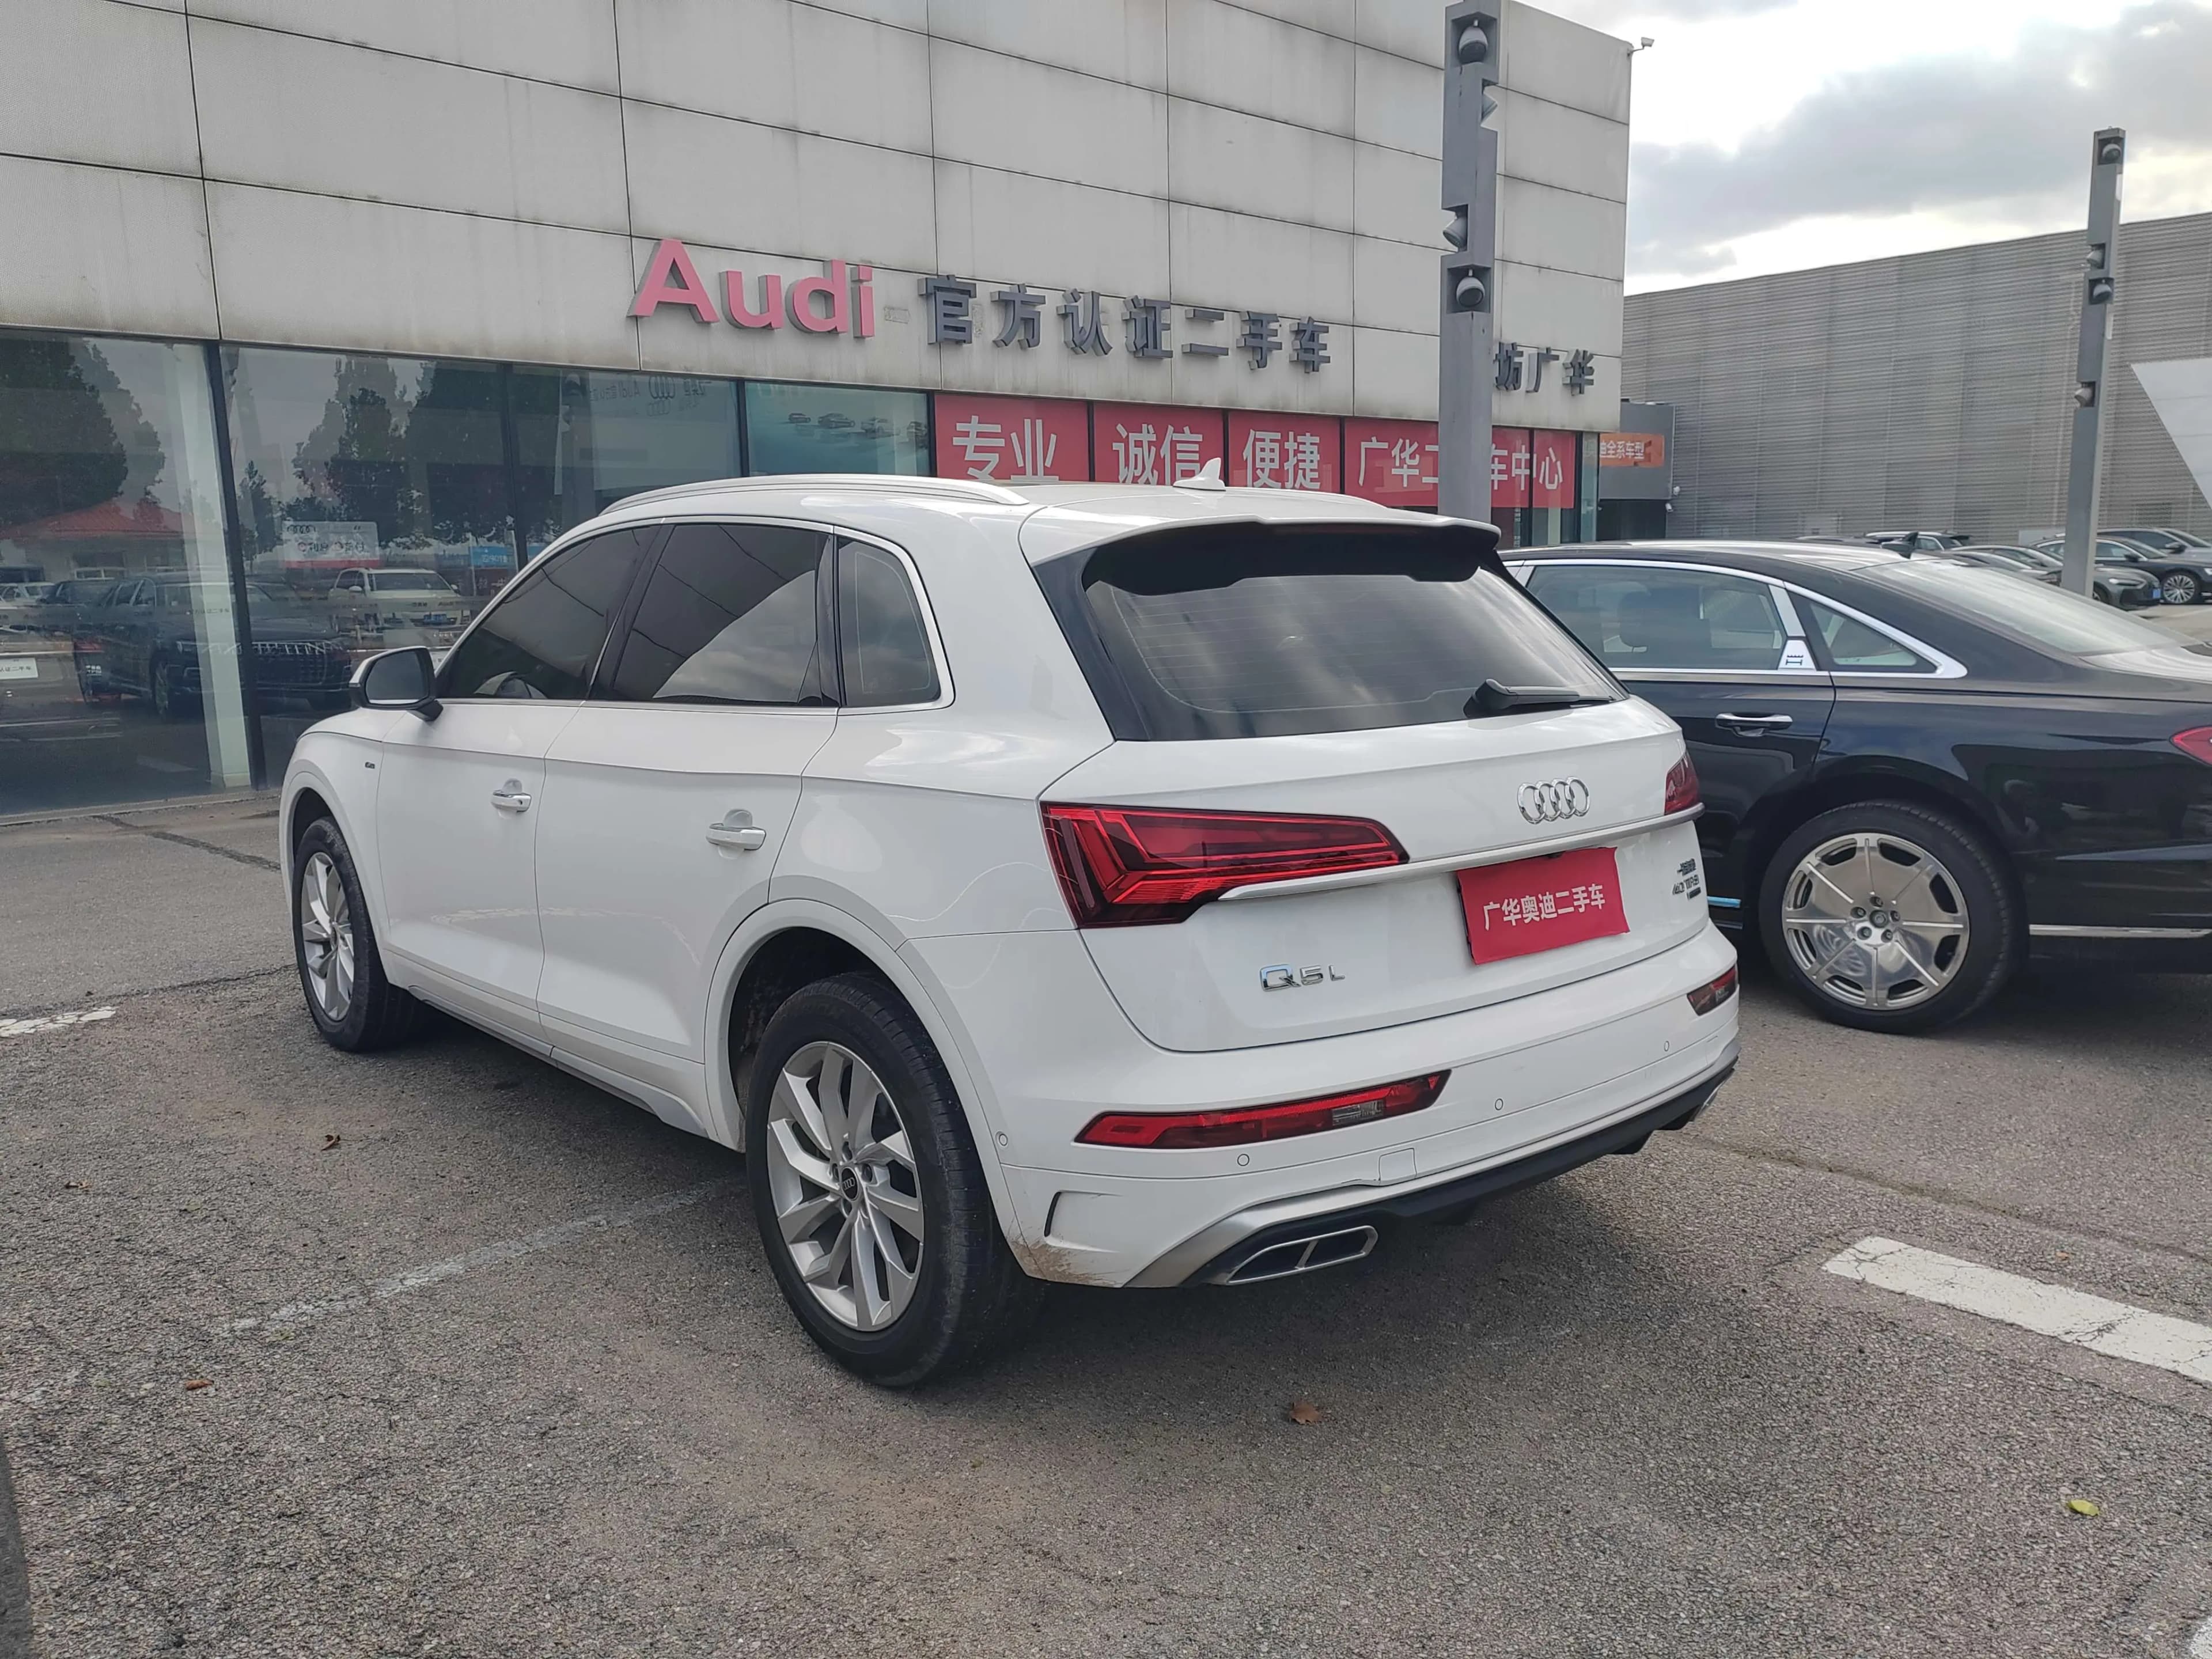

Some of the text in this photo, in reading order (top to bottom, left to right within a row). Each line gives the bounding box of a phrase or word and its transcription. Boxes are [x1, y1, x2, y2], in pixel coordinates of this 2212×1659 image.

[627, 238, 875, 339] Audi
[918, 275, 1331, 373] 官方认证二手车
[952, 415, 1059, 482] 专业
[1112, 423, 1203, 485] 诚信
[1243, 430, 1321, 490] 便捷
[1483, 884, 1605, 931] 广华奥迪二手车
[1259, 964, 1345, 992] Q5L
